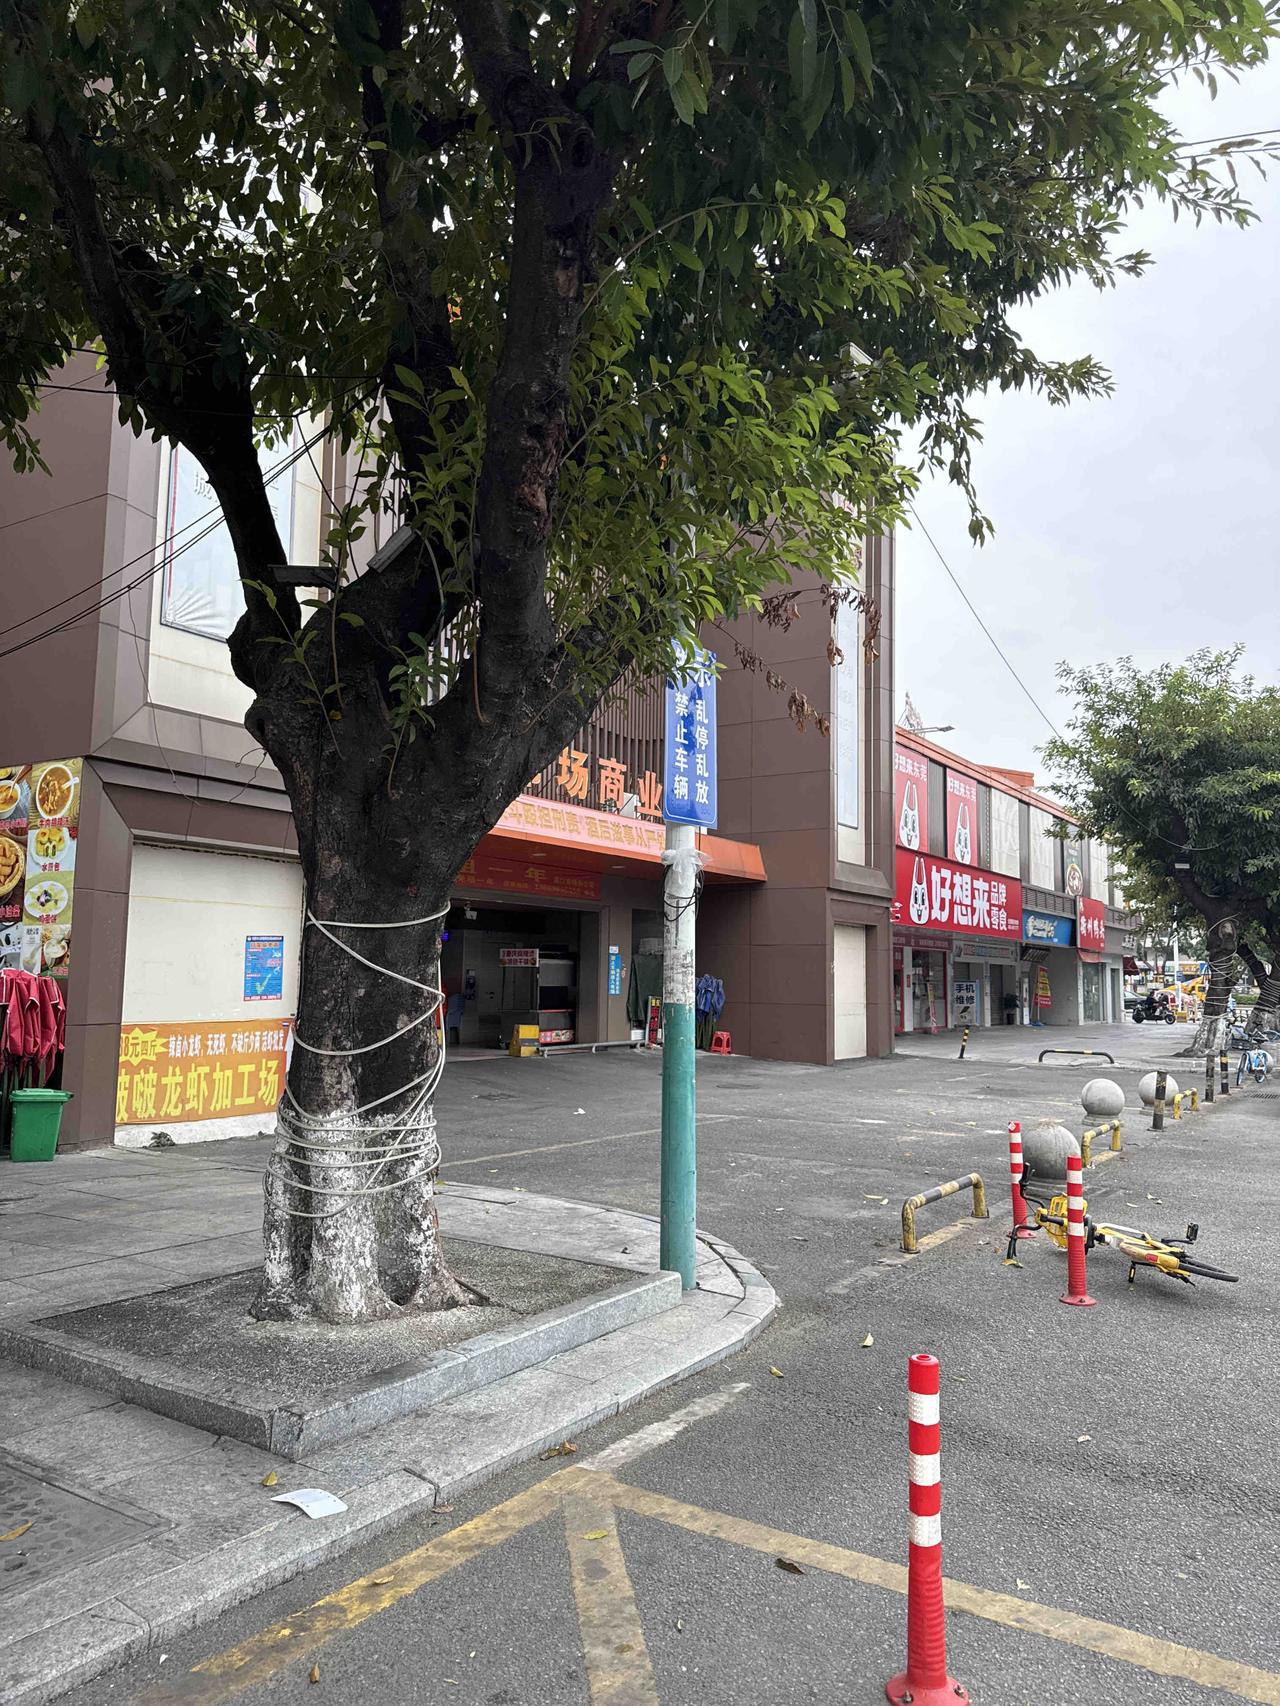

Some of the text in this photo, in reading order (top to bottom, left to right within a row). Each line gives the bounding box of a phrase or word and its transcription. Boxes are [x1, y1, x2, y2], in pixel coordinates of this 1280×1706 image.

[674, 691, 689, 800] 禁止车辆
[695, 700, 710, 805] 乱停乱放
[931, 865, 991, 929] 好想来
[990, 881, 1007, 906] 品牌
[990, 907, 1008, 931] 零食
[955, 983, 975, 993] 手机
[955, 995, 975, 1005] 维修
